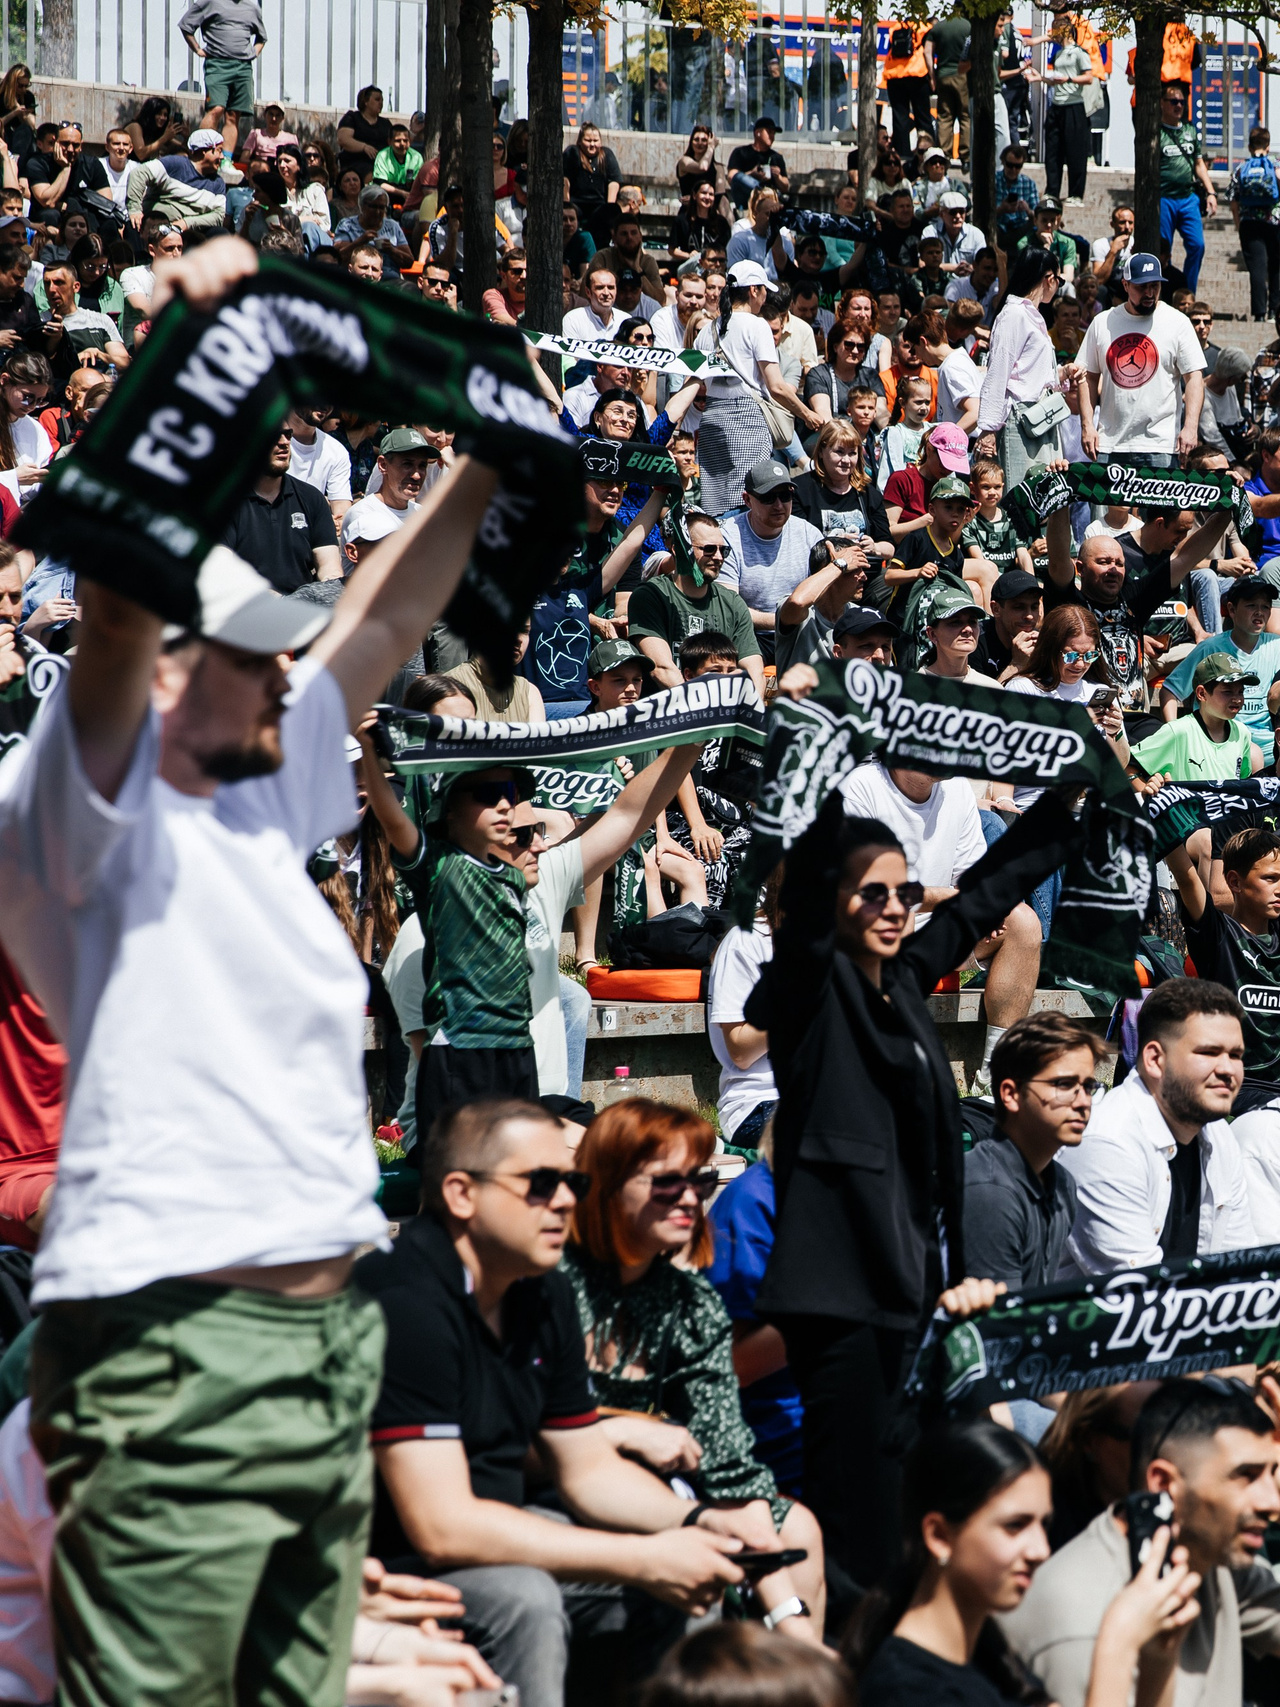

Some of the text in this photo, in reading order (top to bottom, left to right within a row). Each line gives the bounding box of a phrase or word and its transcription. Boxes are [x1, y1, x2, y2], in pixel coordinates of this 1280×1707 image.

[1116, 338, 1150, 350] PARIS
[127, 407, 216, 485] FC
[1106, 463, 1222, 509] Краснодар
[436, 677, 766, 740] KRASNODAR STADIUM
[644, 710, 715, 730] Razvedchika
[843, 657, 1086, 777] Краснодар
[605, 1014, 612, 1026] 9
